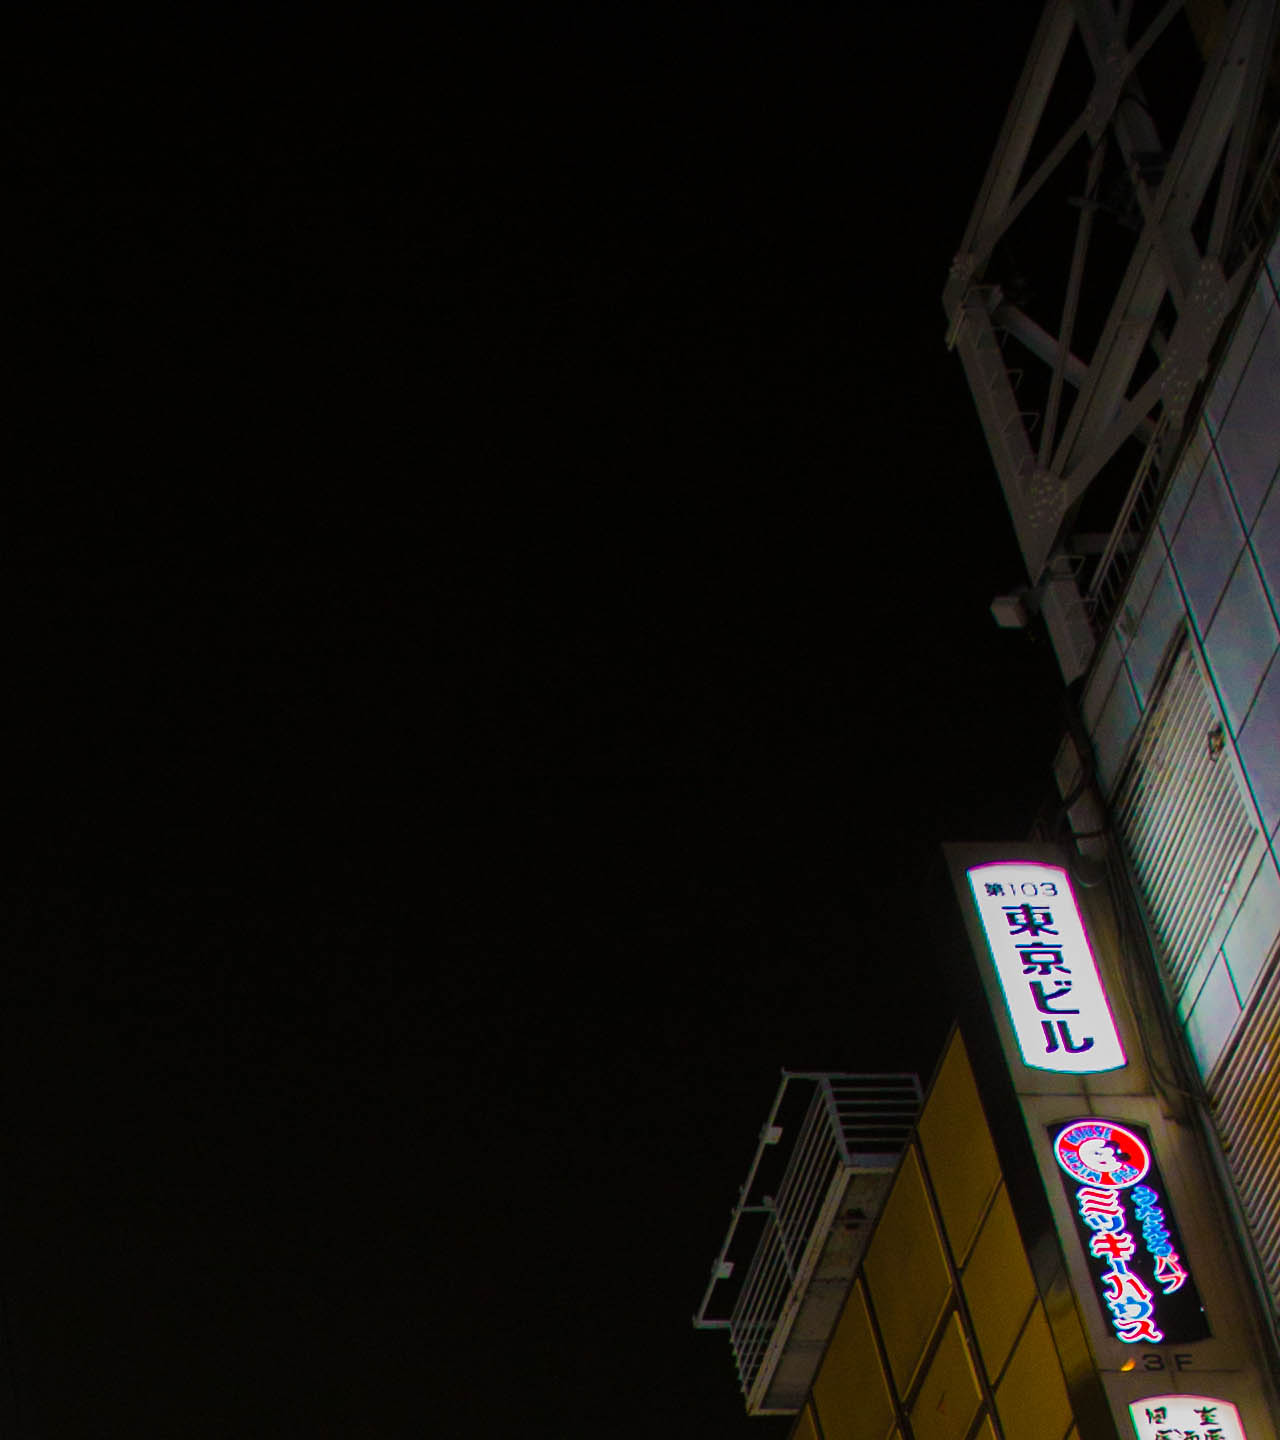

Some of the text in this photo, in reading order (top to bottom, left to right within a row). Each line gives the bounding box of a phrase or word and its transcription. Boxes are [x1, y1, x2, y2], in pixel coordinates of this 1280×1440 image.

[984, 881, 1058, 897] 第103
[1001, 903, 1094, 1053] 東京ビル
